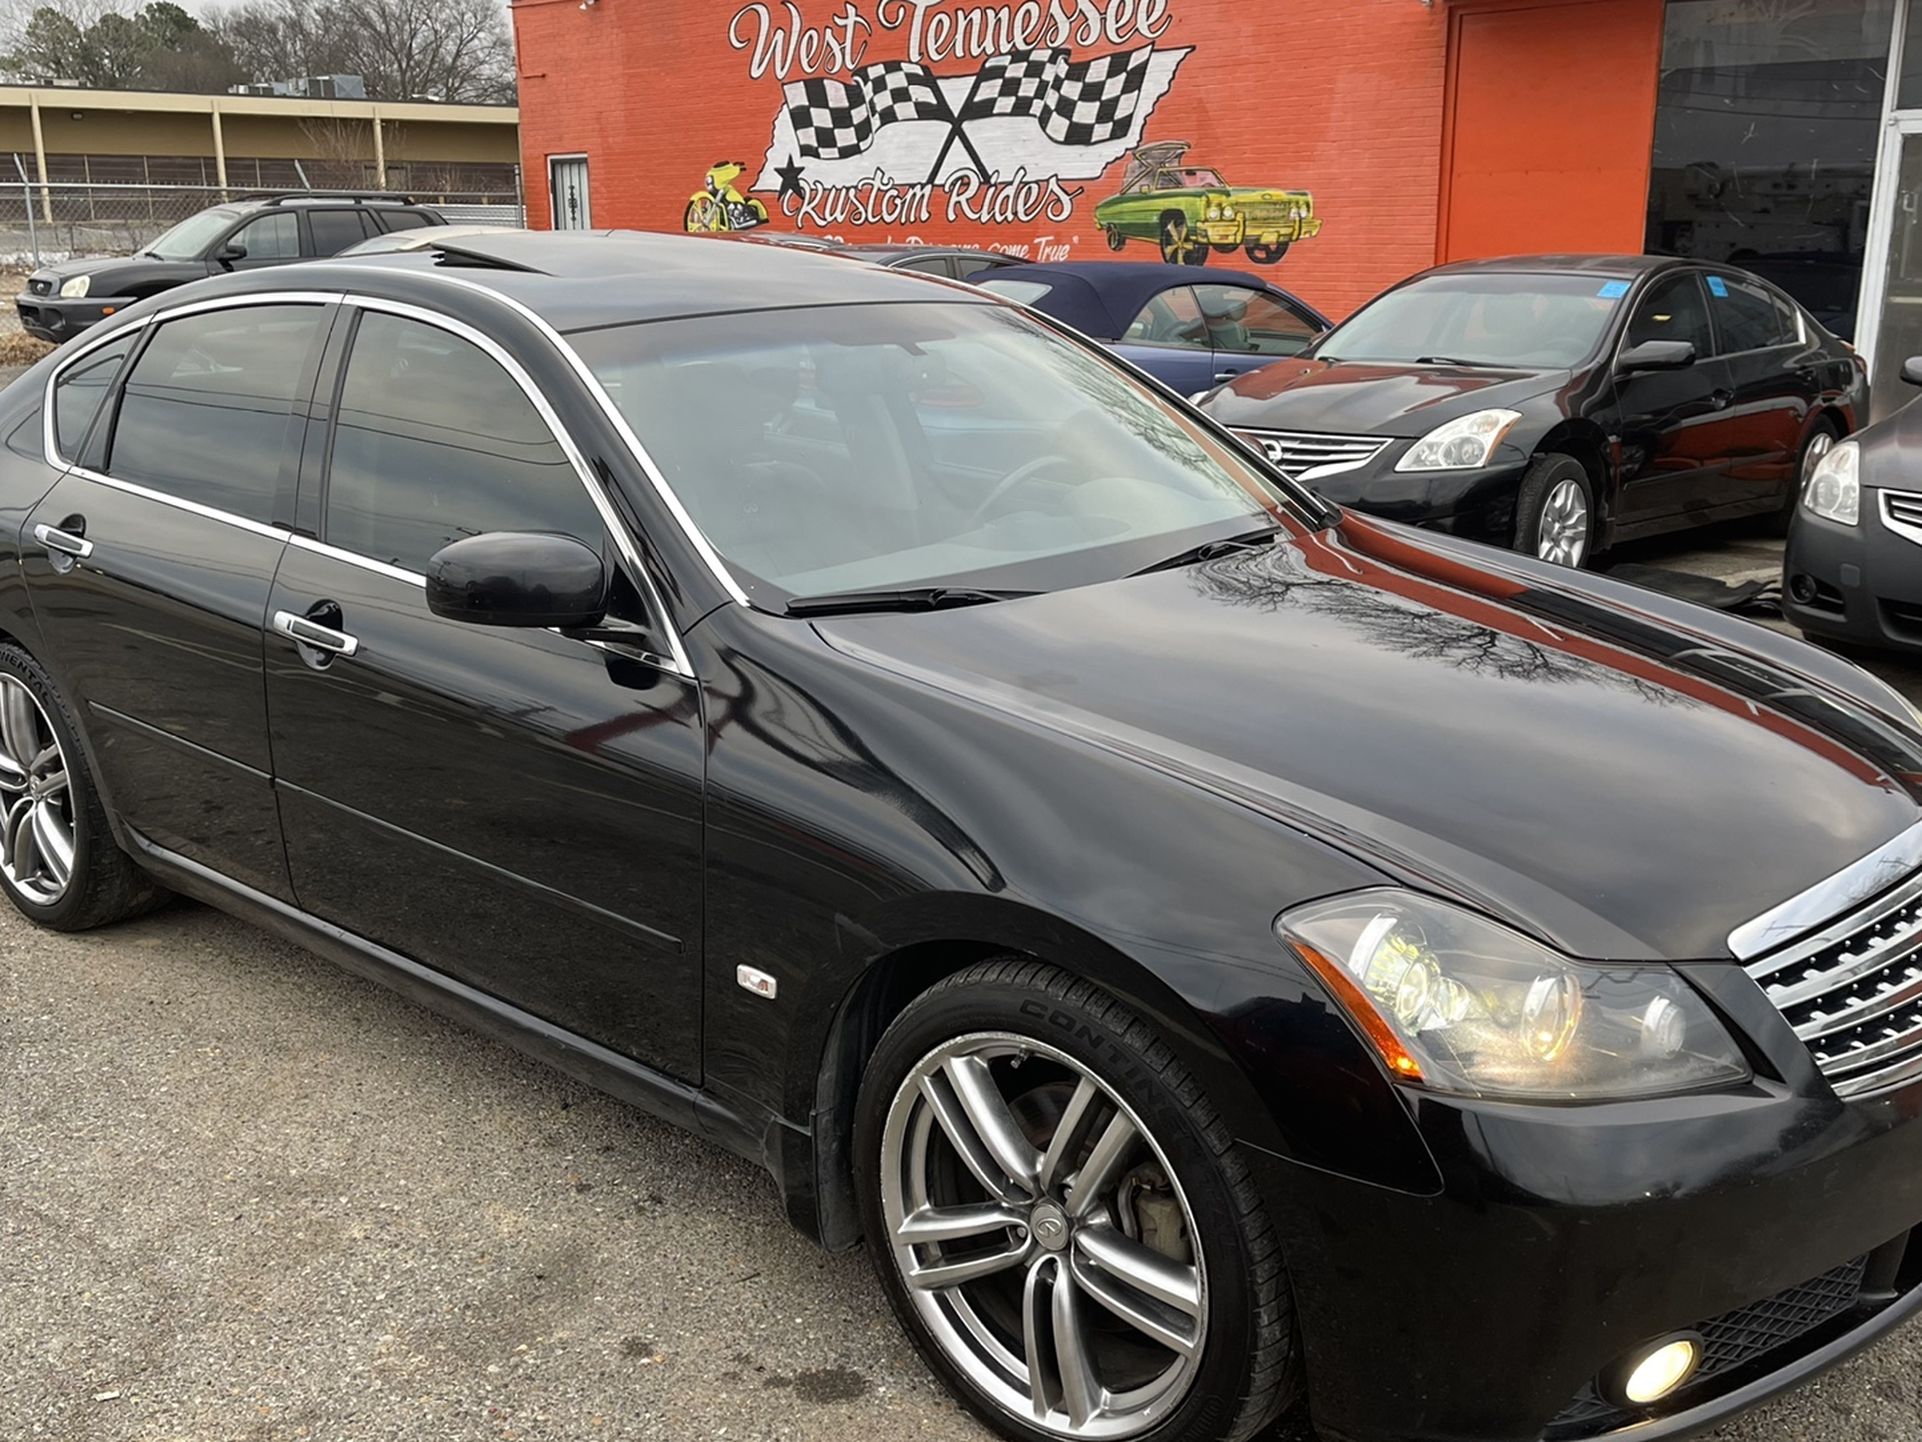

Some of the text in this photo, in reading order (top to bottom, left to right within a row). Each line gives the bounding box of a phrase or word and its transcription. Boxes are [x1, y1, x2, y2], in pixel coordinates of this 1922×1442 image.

[728, 0, 1173, 80] West Tennessee
[782, 166, 1084, 228] Kustom Rides
